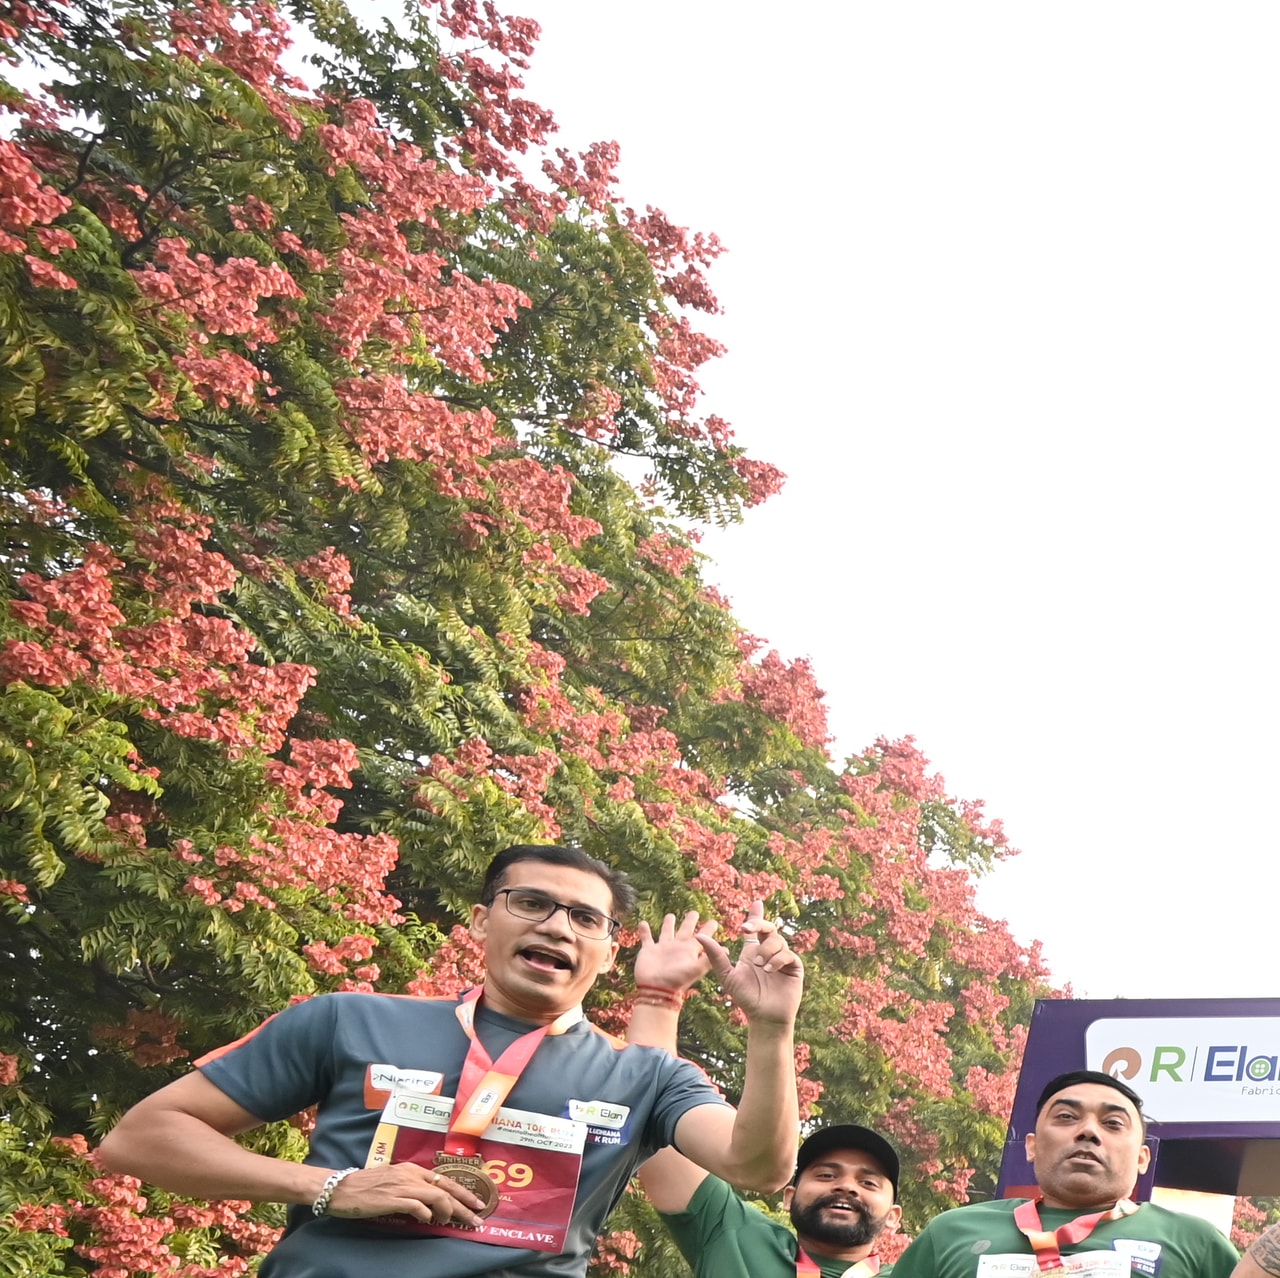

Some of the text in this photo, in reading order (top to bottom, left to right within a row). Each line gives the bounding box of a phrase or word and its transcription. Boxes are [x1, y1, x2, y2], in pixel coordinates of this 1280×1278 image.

[536, 1138, 552, 1146] OCT
[484, 1159, 534, 1188] 69
[489, 1226, 554, 1244] ENCLAVE
